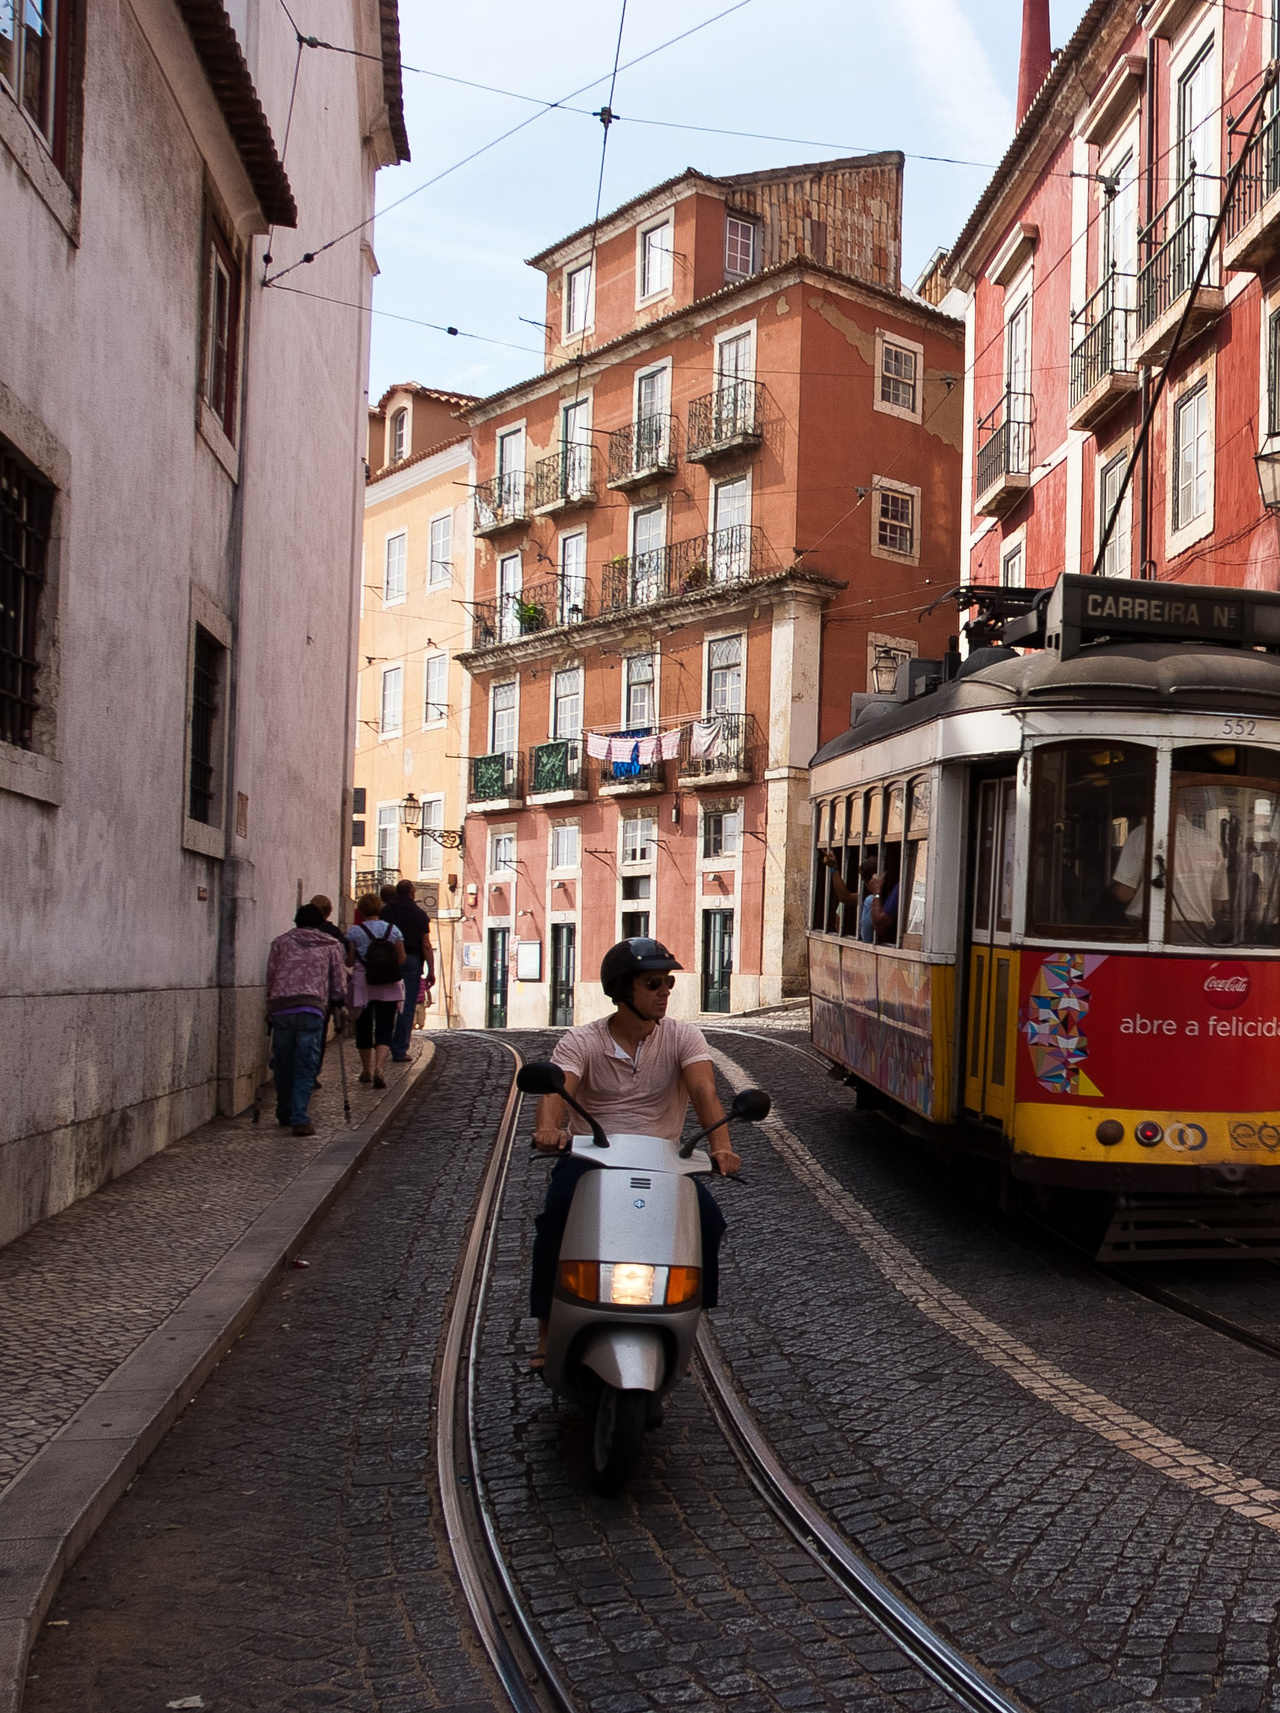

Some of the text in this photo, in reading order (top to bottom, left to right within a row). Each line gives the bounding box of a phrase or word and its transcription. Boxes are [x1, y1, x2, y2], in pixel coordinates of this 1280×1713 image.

[1086, 593, 1200, 625] CARREIRA
[1222, 719, 1256, 736] 552
[1119, 1013, 1178, 1036] abre
[1184, 1020, 1200, 1036] a
